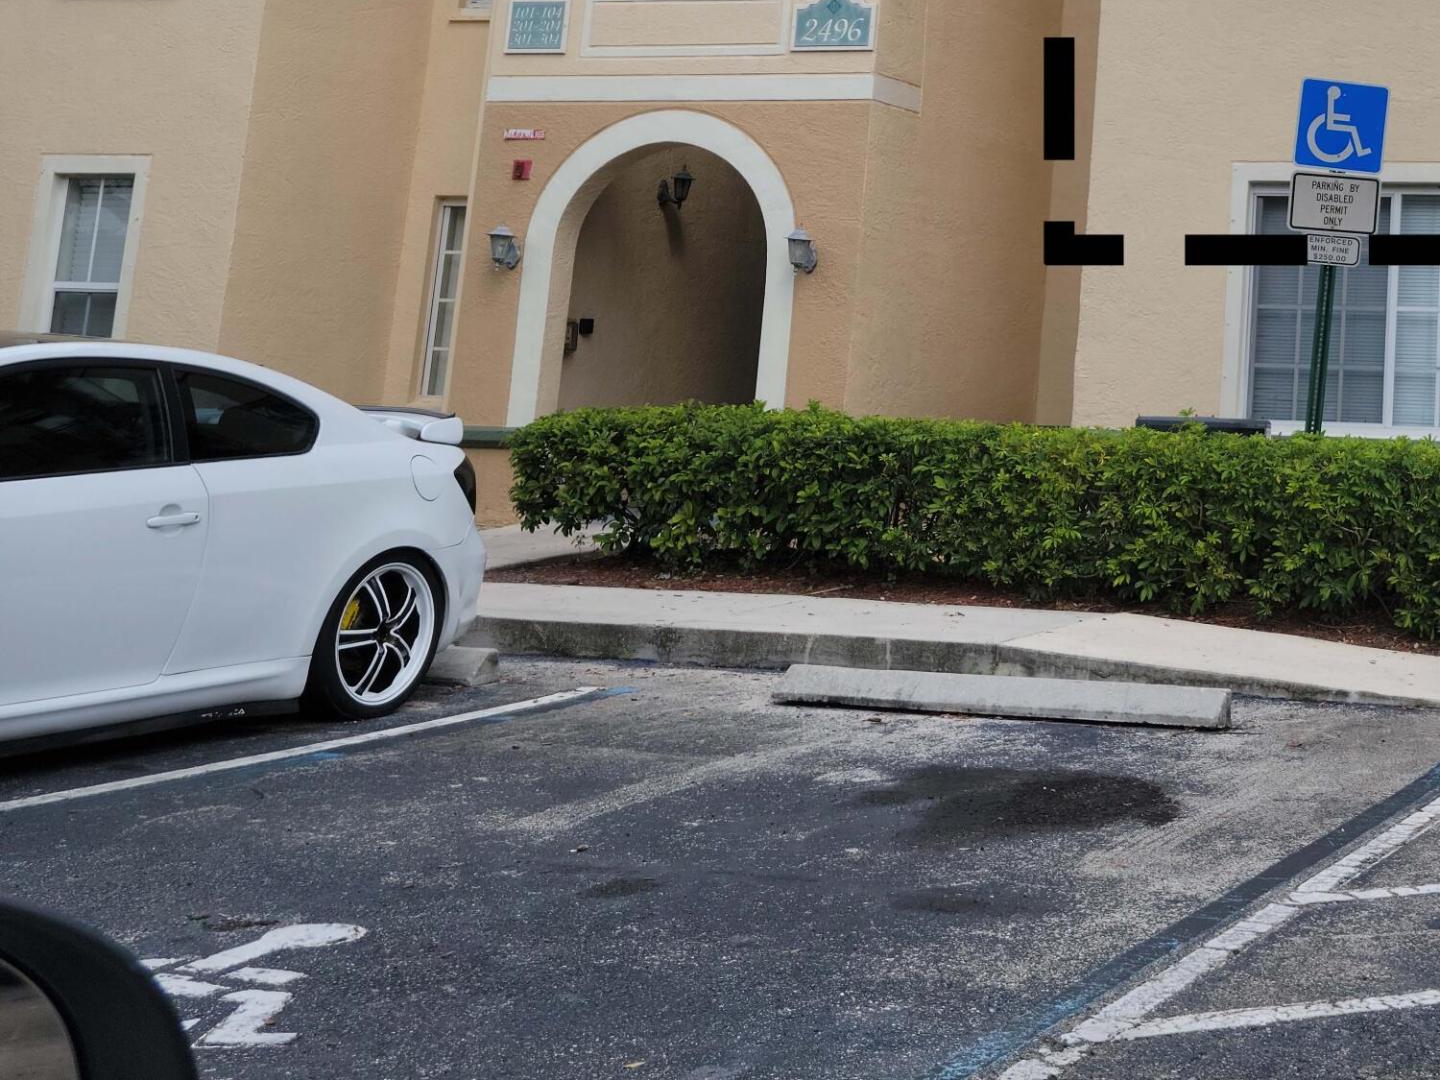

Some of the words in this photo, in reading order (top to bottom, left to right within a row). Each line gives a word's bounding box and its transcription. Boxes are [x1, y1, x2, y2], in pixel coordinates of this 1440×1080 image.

[799, 17, 865, 42] 2496
[1311, 180, 1344, 192] PARKING
[1349, 183, 1361, 193] BY
[1316, 192, 1354, 204] DISABLED
[1319, 204, 1348, 215] PERMIT
[1323, 216, 1343, 227] ONLY
[1308, 235, 1353, 247] ENFORCED
[1331, 247, 1350, 255] FINE
[1313, 253, 1347, 262] $250.00
